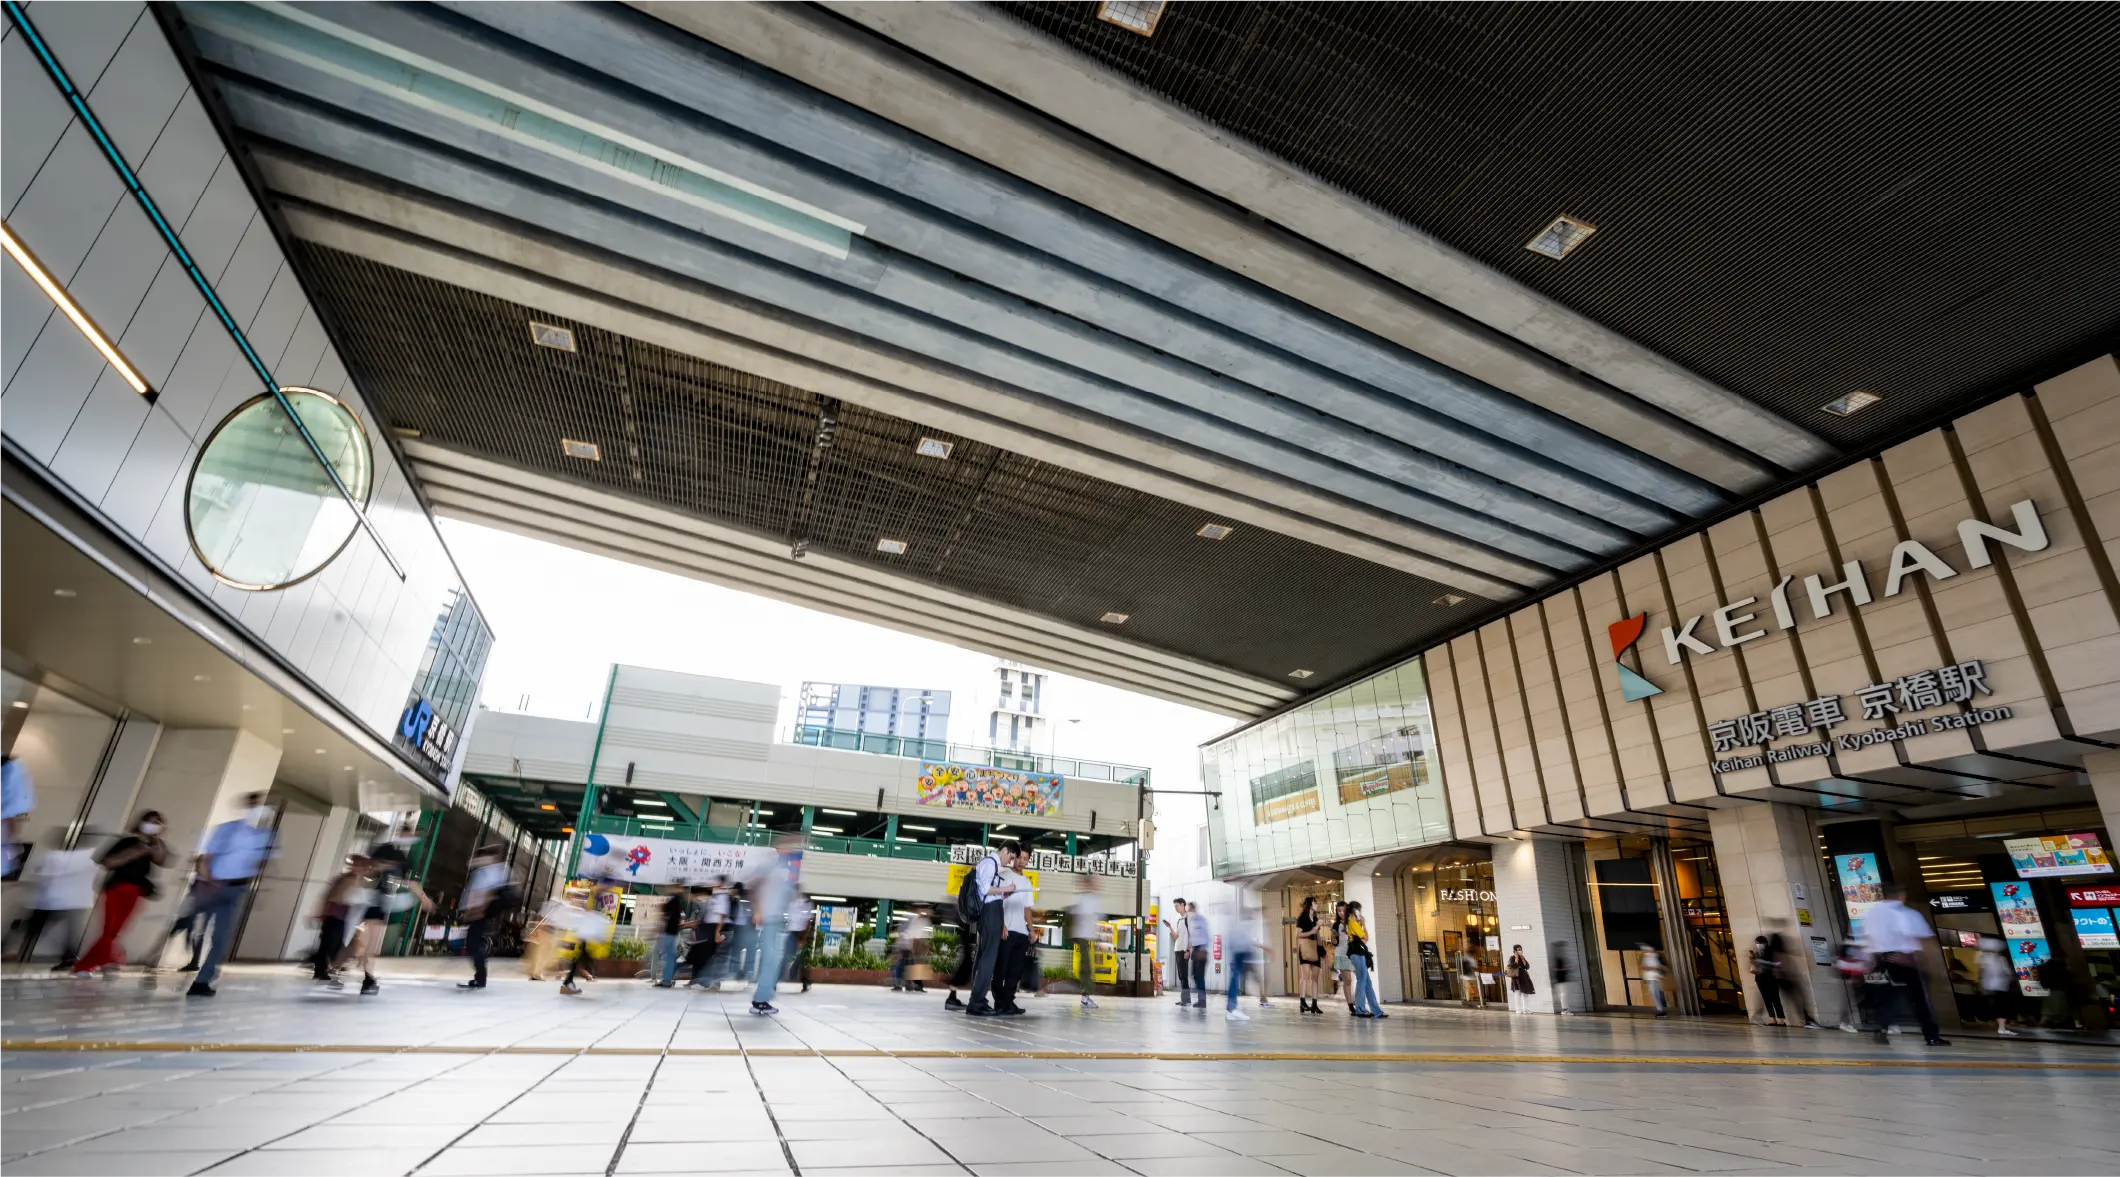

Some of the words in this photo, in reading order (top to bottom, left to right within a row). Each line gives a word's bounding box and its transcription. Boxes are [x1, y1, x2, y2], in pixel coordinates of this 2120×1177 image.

[1660, 498, 2050, 666] KEIHAN
[400, 698, 433, 749] JR
[1707, 694, 1848, 752] 京阪電車
[1854, 659, 1995, 721] 京橋駅
[1710, 755, 1766, 775] Keihan
[1766, 741, 1834, 765] Railway
[1838, 719, 1928, 751] Kyobashi
[1930, 705, 2014, 733] Station
[666, 856, 745, 869] 大阪・関西万博
[953, 846, 1136, 876] 京橋自転車駐車場
[1440, 889, 1497, 902] FASHION
